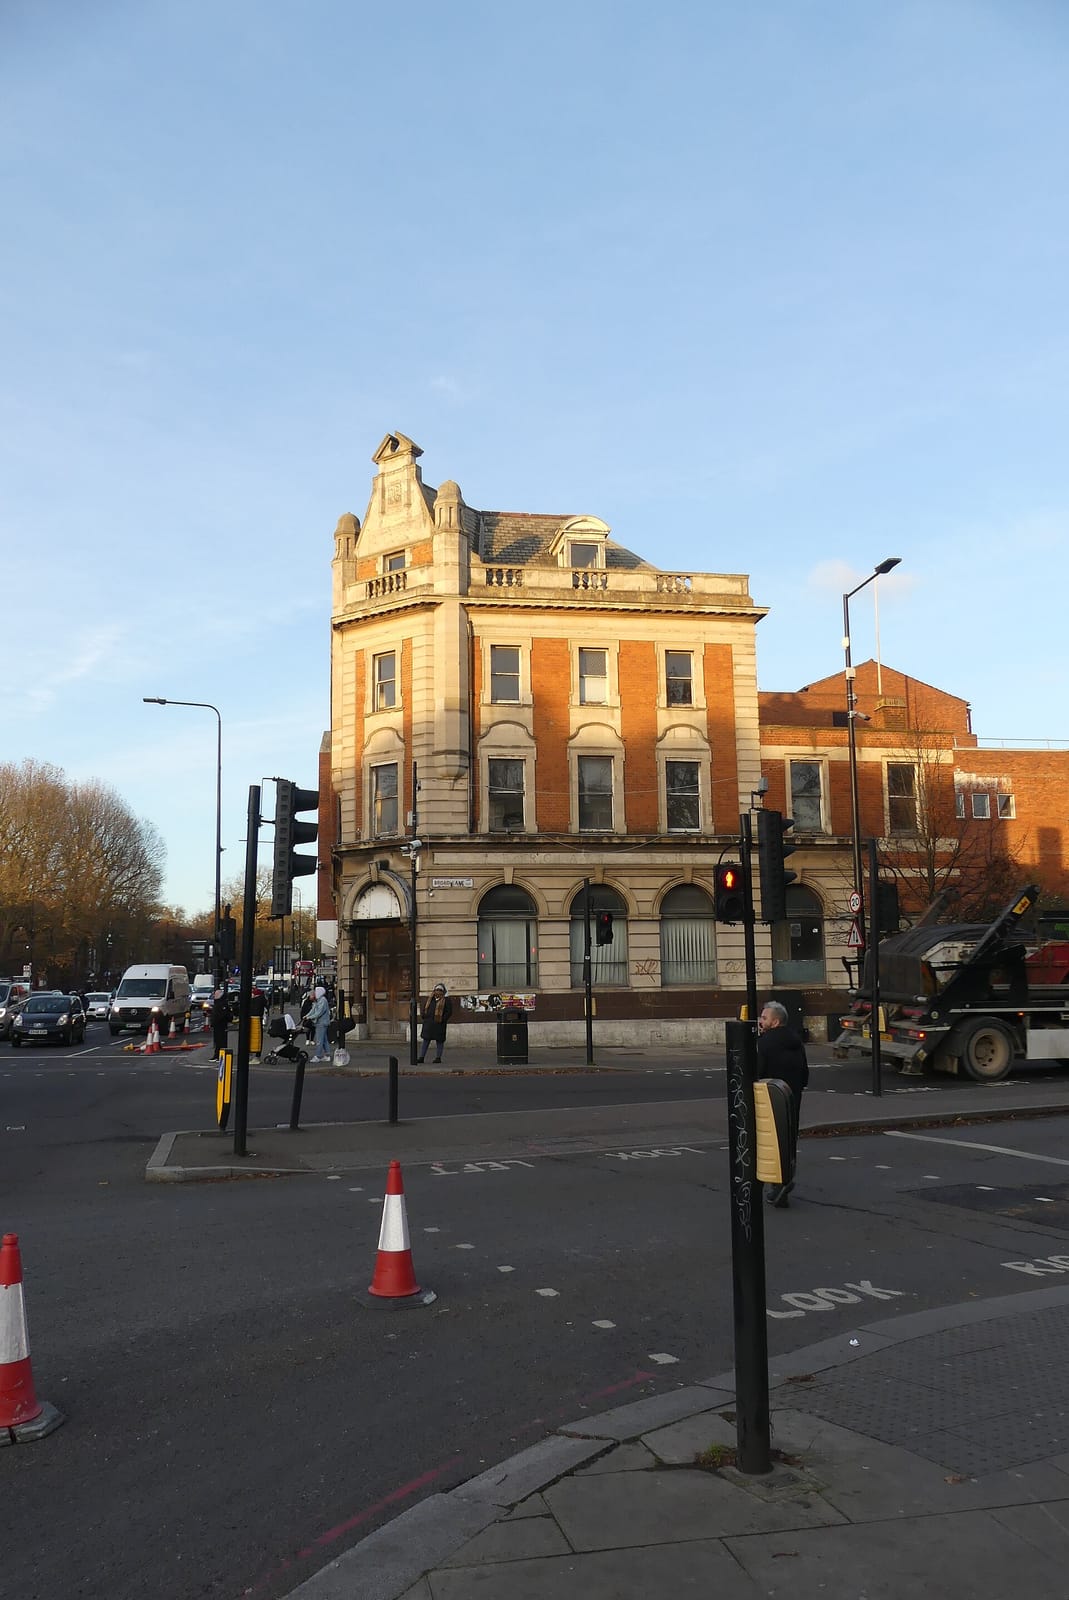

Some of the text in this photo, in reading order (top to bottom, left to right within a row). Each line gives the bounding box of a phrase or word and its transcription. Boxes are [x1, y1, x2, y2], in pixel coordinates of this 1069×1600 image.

[851, 897, 859, 906] 20
[430, 1147, 706, 1176] LOOK LEFT
[766, 1280, 903, 1319] LOOK
